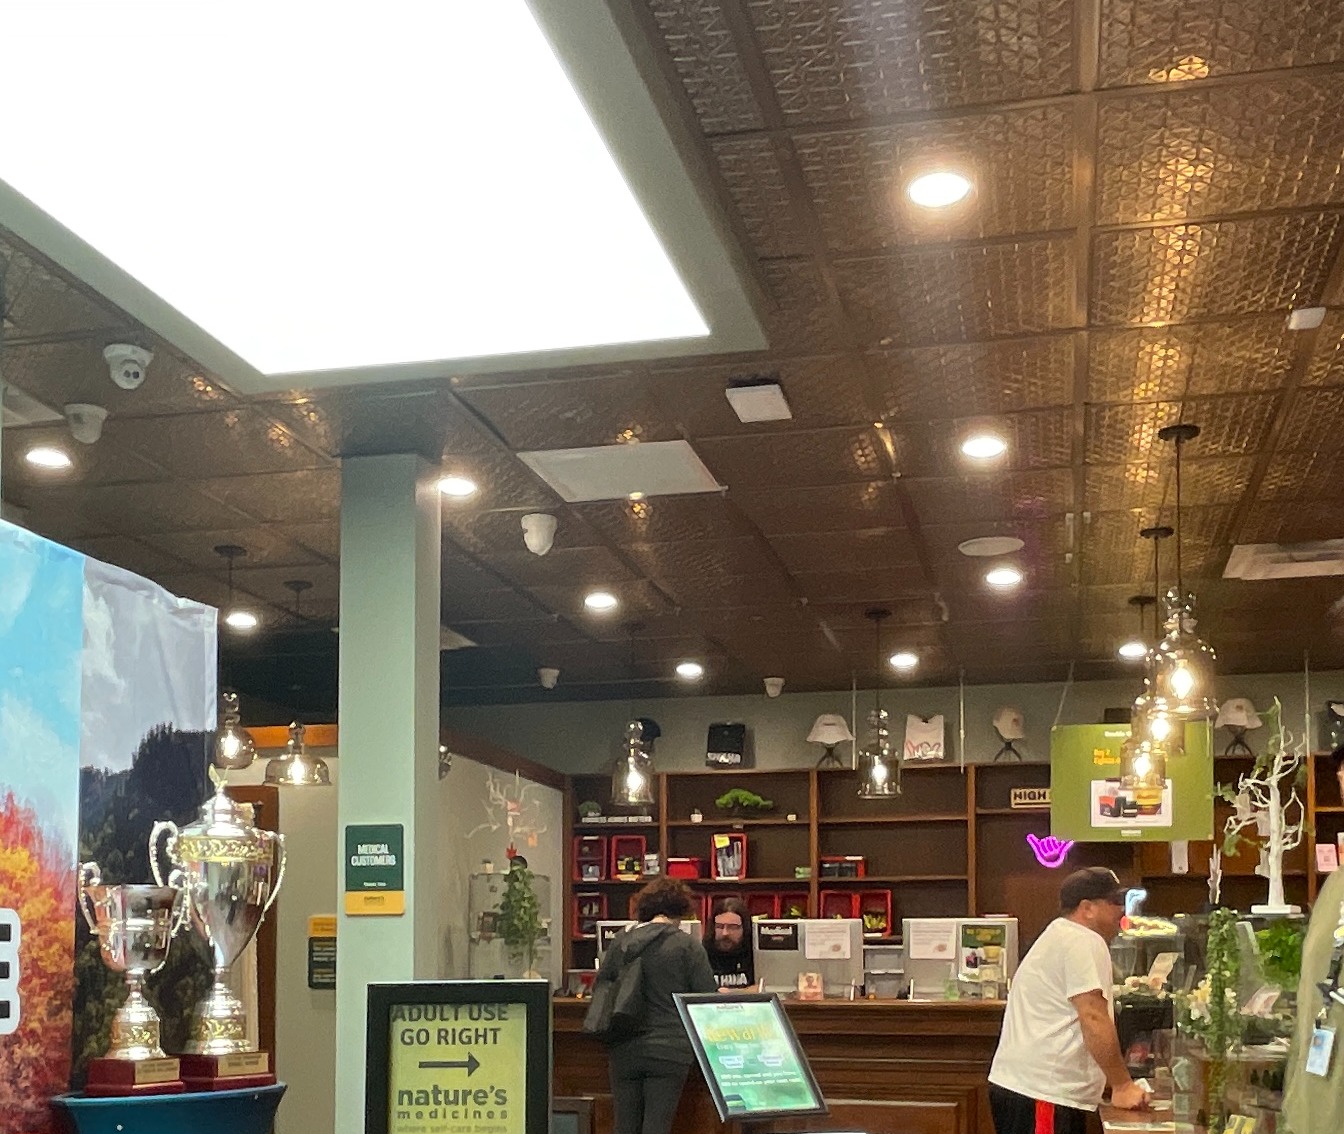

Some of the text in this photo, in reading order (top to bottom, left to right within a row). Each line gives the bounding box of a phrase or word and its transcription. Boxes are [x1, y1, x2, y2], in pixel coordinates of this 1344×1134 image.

[357, 843, 390, 855] MEDICAL
[350, 855, 397, 867] CUSTOMERS
[468, 1004, 509, 1022] USE
[400, 1028, 502, 1046] GO RIGHT
[397, 1084, 508, 1107] nature's
[397, 1108, 508, 1120] medicines
